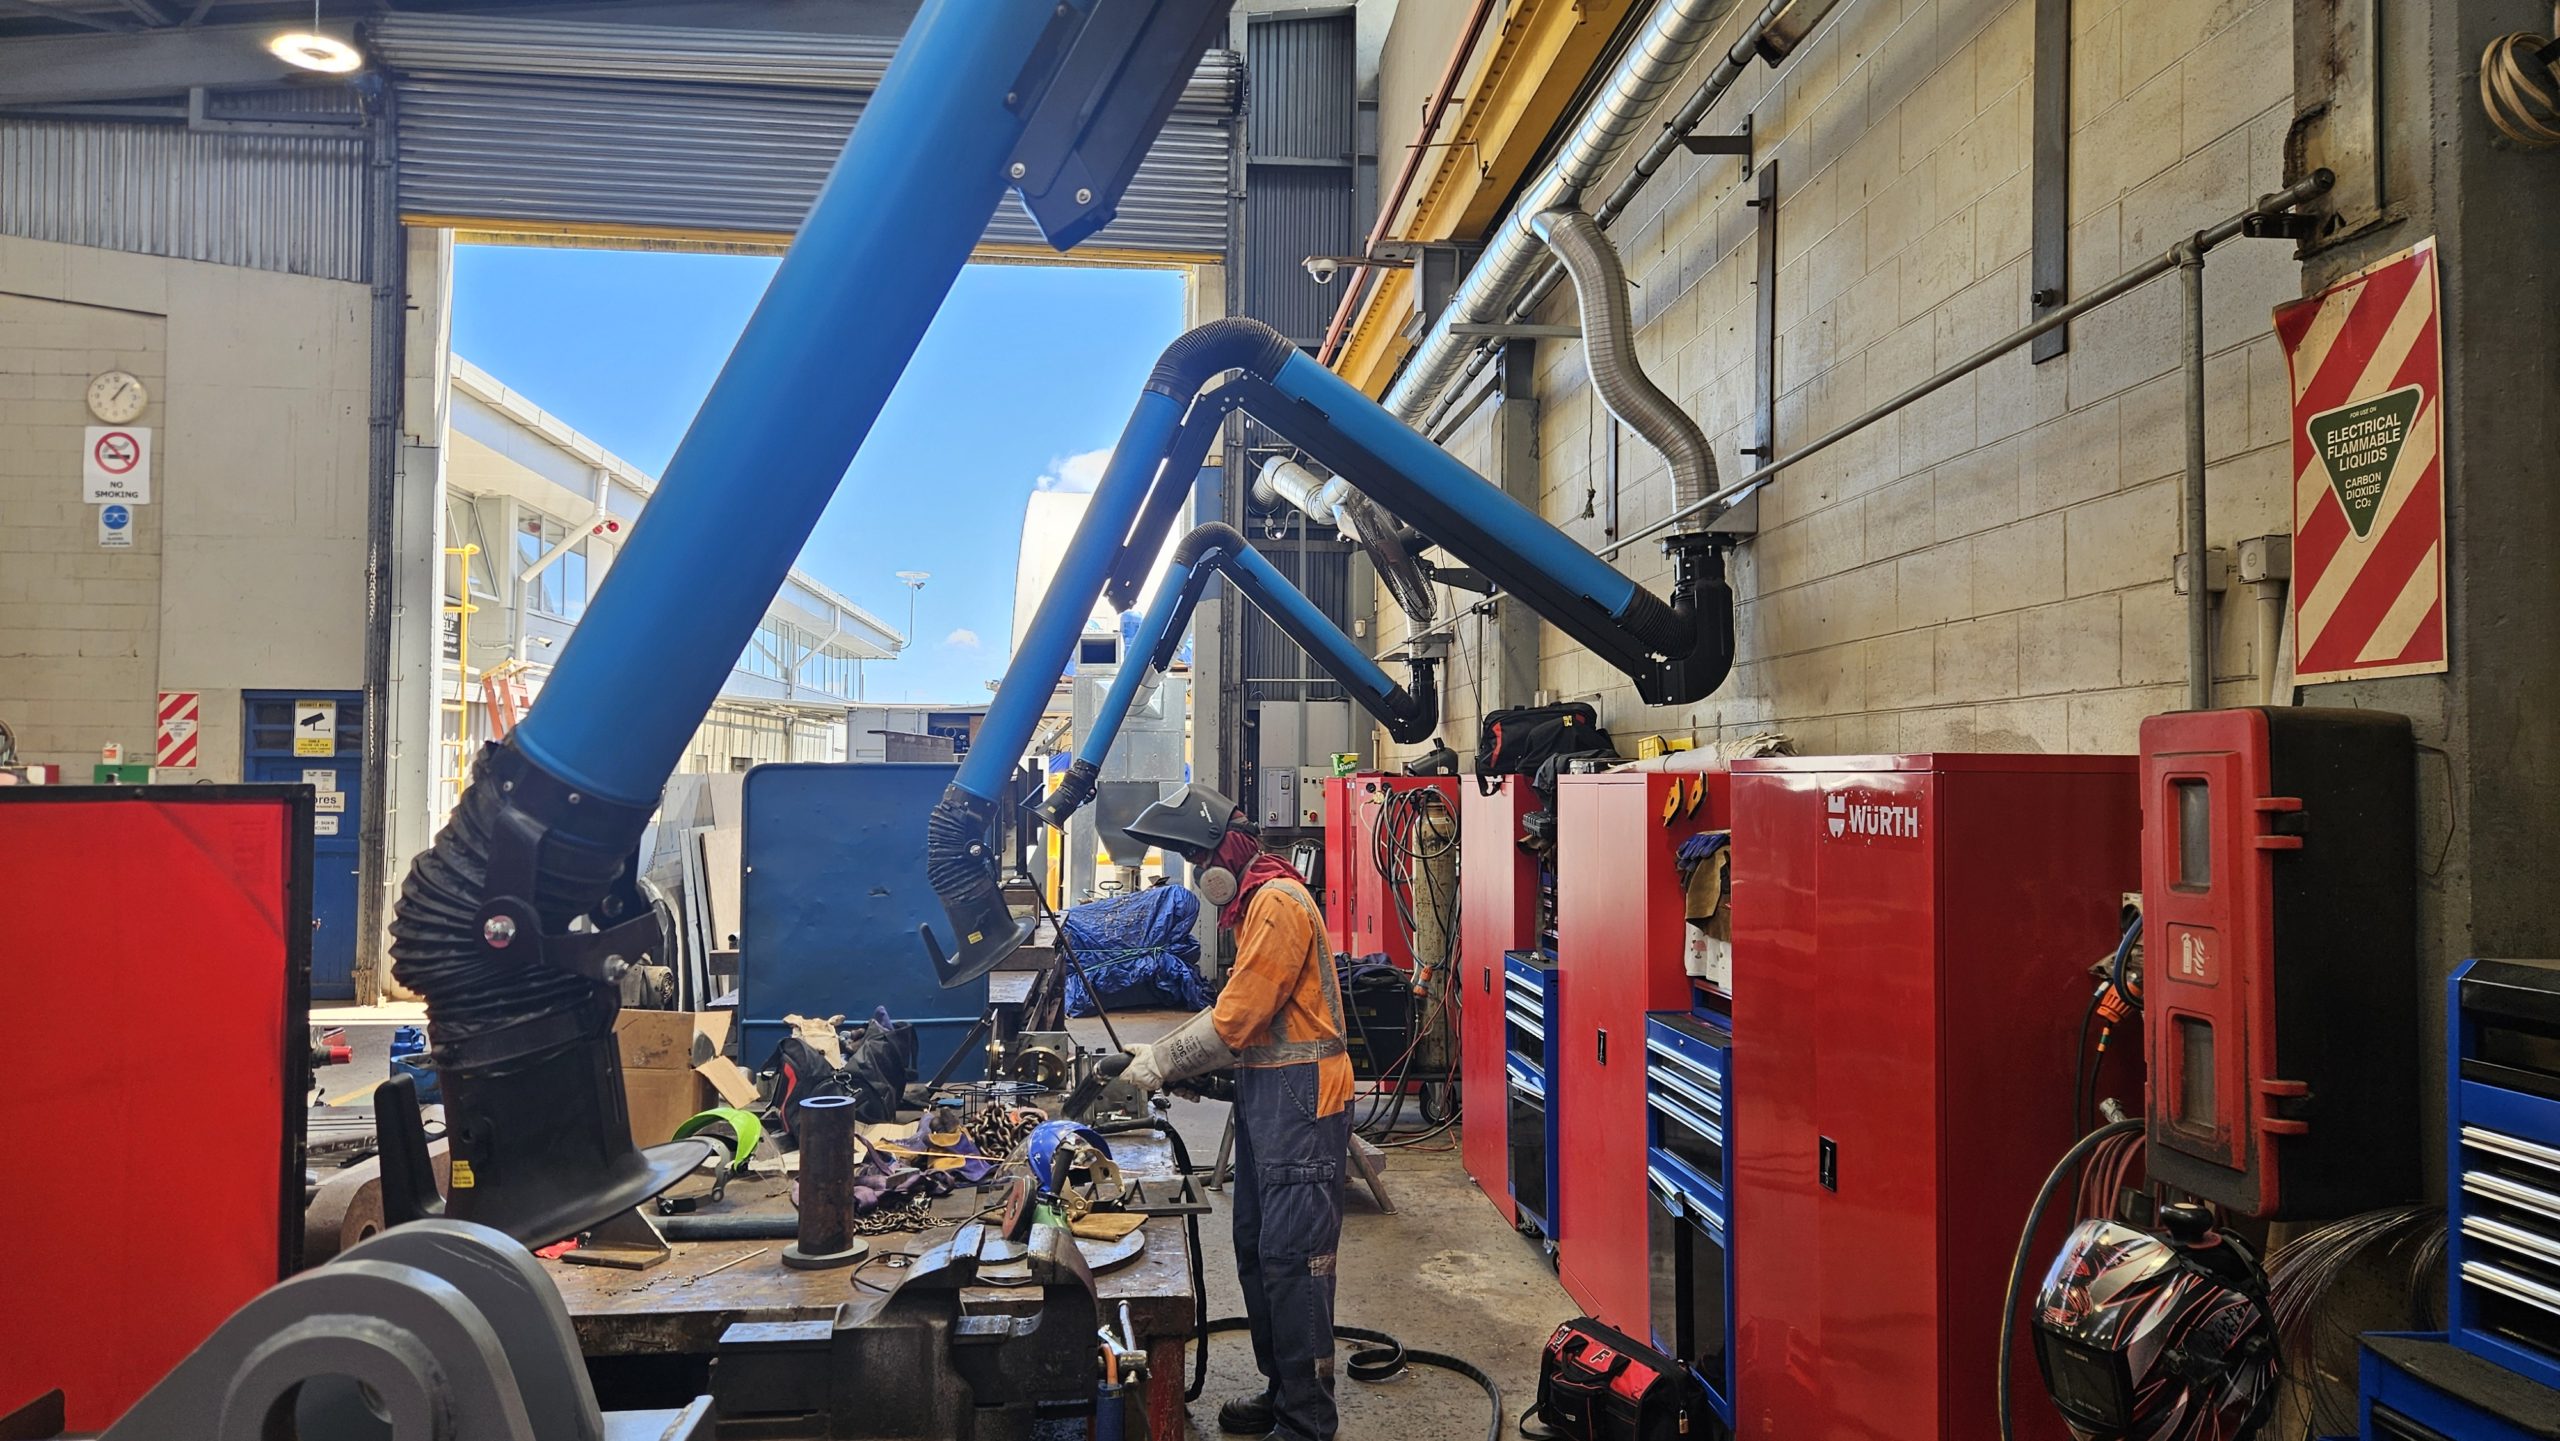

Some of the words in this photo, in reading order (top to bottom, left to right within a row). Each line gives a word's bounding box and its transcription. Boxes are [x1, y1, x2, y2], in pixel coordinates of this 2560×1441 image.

[2349, 410, 2360, 418] FOR
[2359, 408, 2369, 416] USE
[2327, 412, 2402, 445] ELECTRICAL
[2327, 427, 2401, 460] FLAMMABLE
[2339, 446, 2388, 472] LIQUIDS
[110, 481, 124, 489] NO
[2345, 472, 2382, 489] CARBON
[95, 490, 139, 499] SMOKING
[2346, 483, 2381, 500] DIOXIDE
[1848, 804, 1919, 838] WÜRTH
[1175, 1039, 1187, 1058] 305
